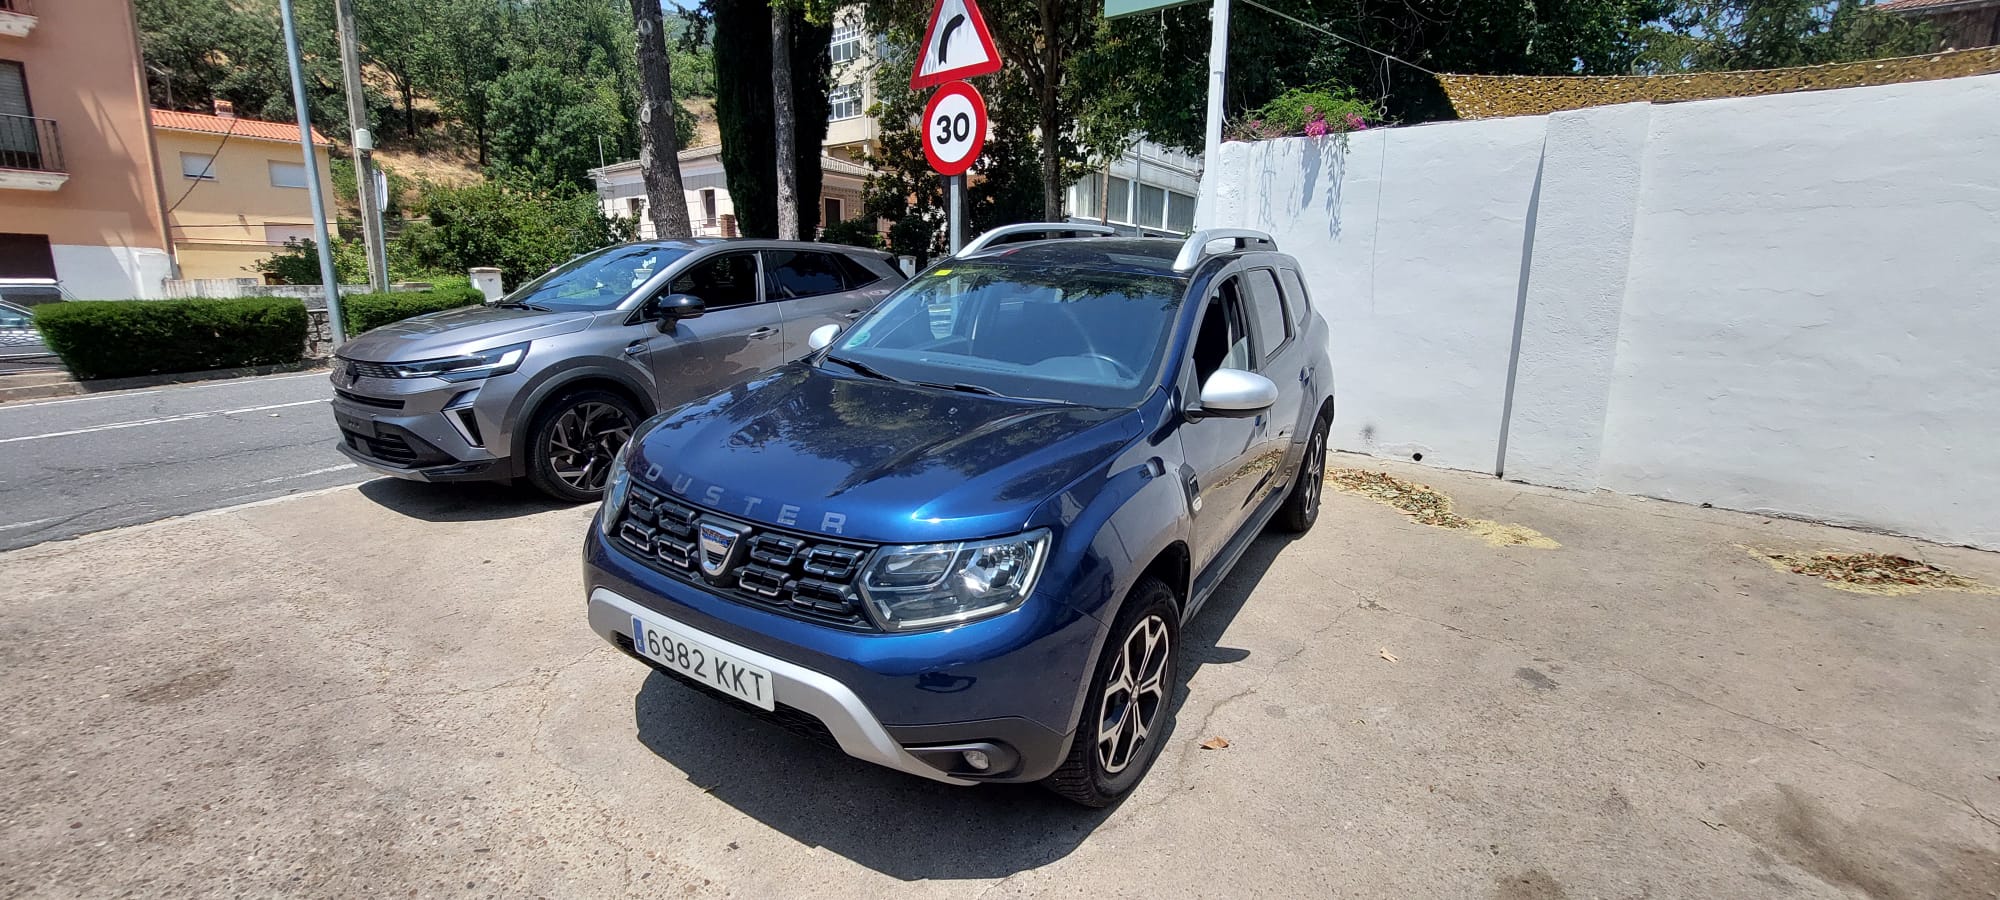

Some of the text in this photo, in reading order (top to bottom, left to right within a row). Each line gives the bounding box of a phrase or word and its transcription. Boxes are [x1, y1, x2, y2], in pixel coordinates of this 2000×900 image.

[937, 112, 970, 145] 30
[645, 463, 847, 534] DUSTER
[647, 629, 764, 702] 6982 KKT
